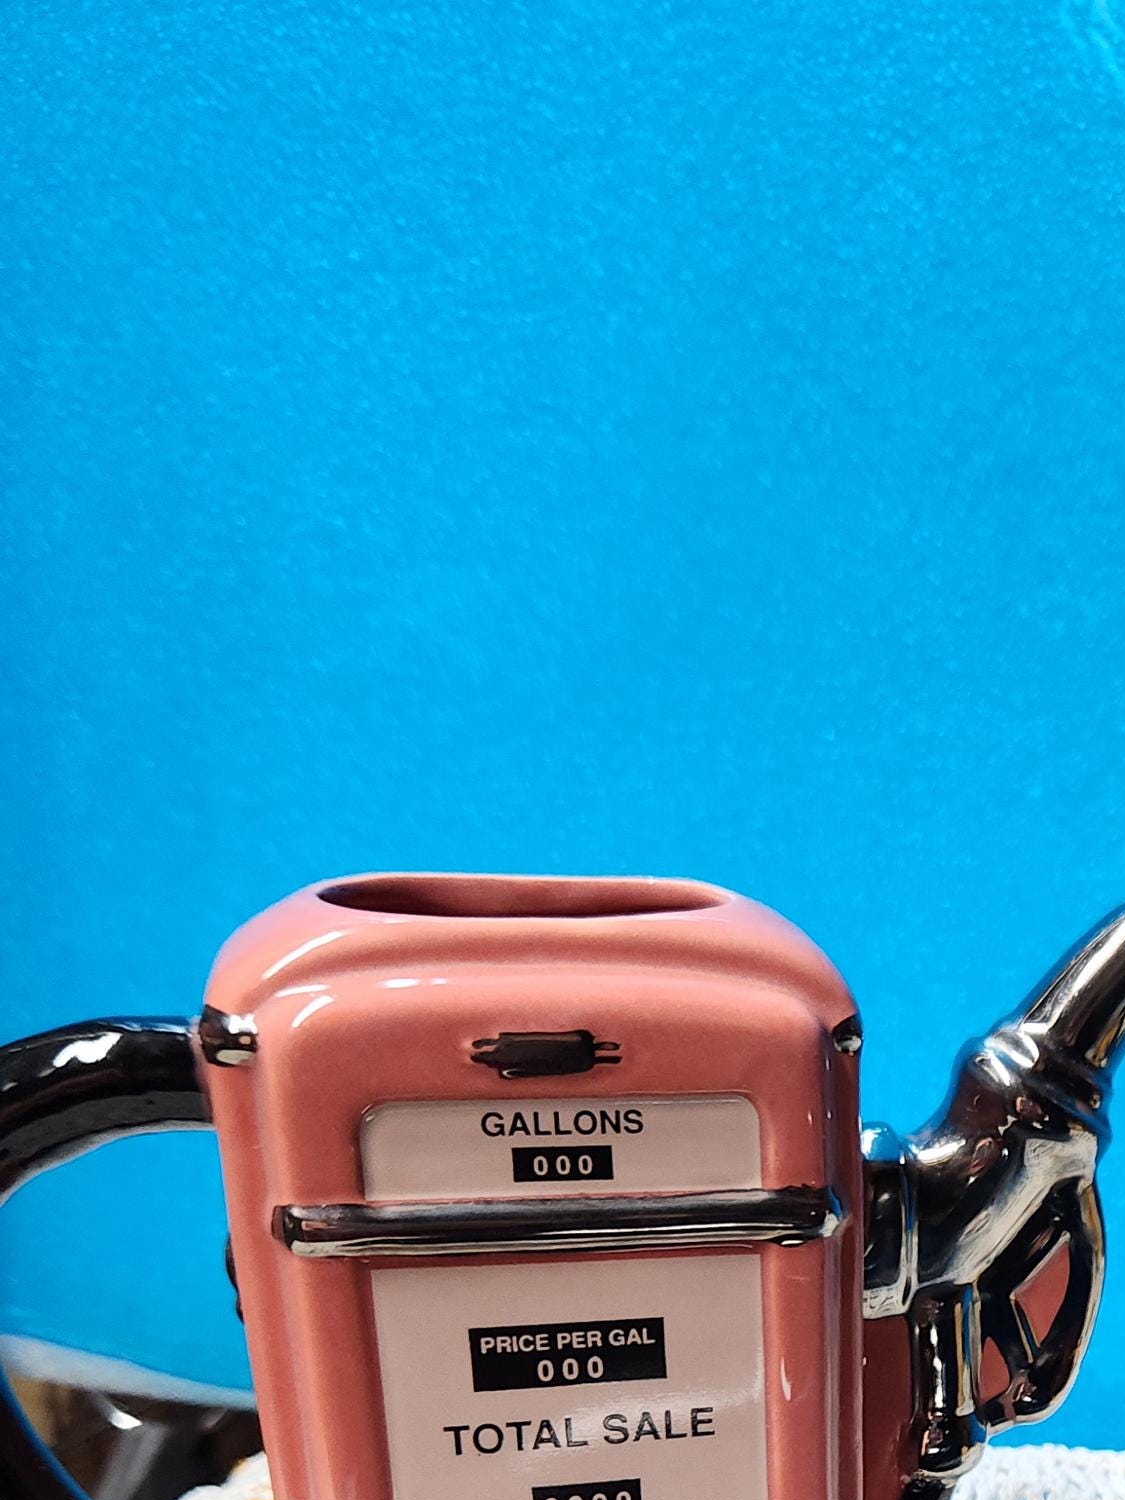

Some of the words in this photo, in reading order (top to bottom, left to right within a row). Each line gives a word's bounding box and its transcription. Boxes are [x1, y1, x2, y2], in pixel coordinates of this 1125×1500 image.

[481, 1109, 644, 1137] GALLONS
[480, 1334, 551, 1354] PRICE
[556, 1331, 602, 1350] PER
[608, 1327, 656, 1346] GAL
[443, 1418, 588, 1456] TOTAL
[603, 1407, 716, 1443] SALE
